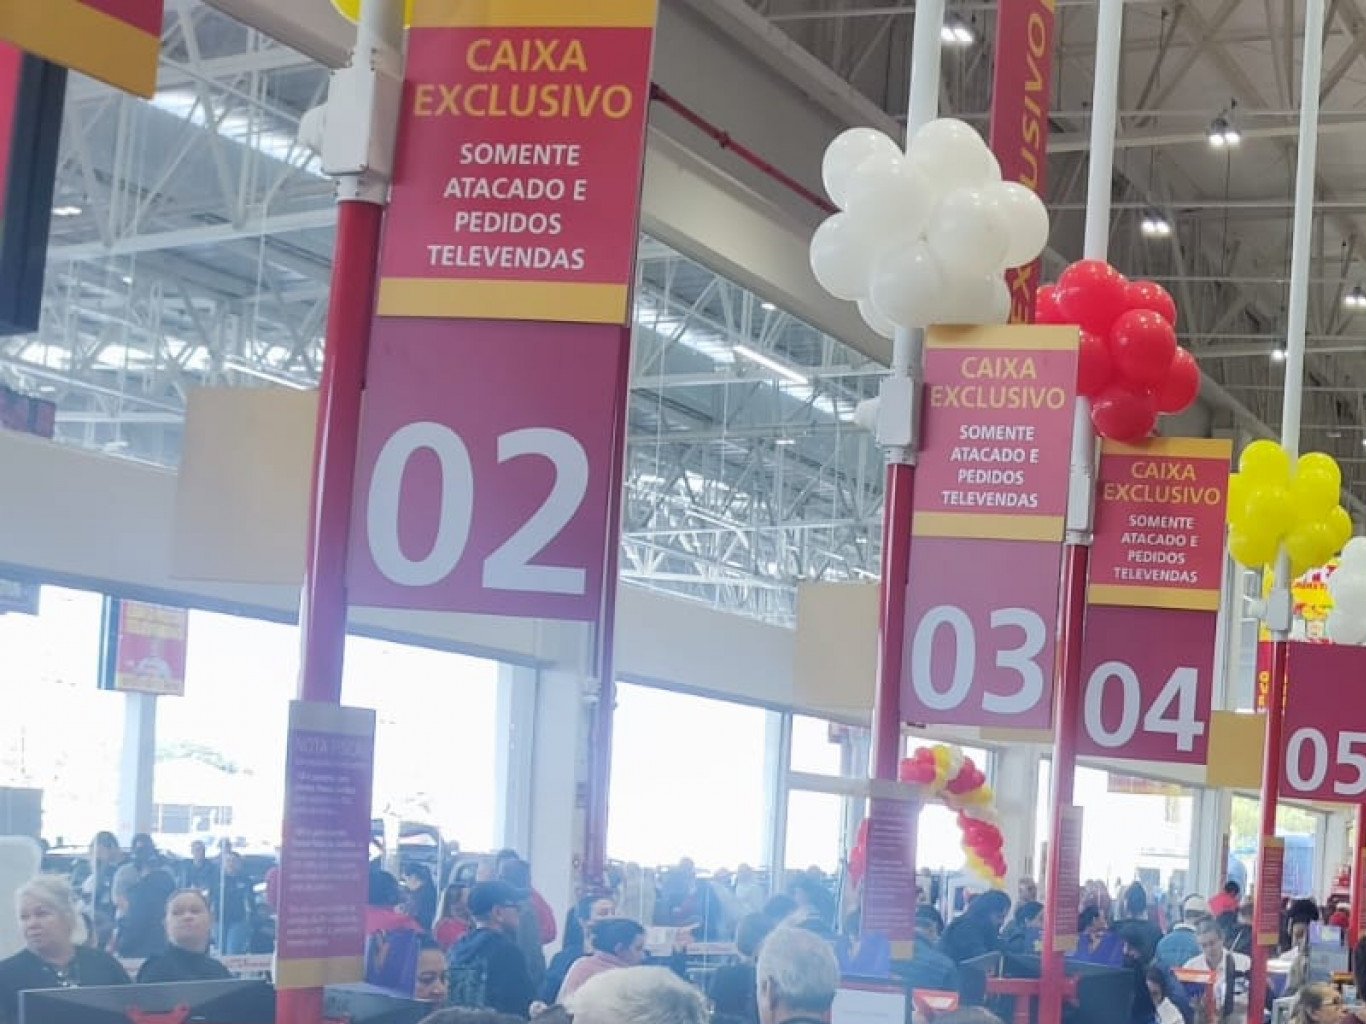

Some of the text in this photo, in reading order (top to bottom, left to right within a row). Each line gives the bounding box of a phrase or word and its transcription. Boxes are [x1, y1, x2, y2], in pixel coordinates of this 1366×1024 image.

[466, 39, 588, 73] CAIXA
[413, 83, 633, 119] EXCLUSIVO
[460, 142, 581, 167] SOMENTE
[1009, 12, 1047, 324] EXUSIVO
[443, 177, 587, 201] ATACADO E
[455, 211, 562, 235] PEDIDOS
[427, 245, 585, 270] TELEVENDAS
[961, 356, 1038, 380] CAIXA
[930, 386, 1067, 411] EXCLUSIVO
[959, 424, 1035, 442] SOMENTE
[950, 447, 1040, 464] ATACADO E
[957, 468, 1024, 486] PEDIDOS
[1130, 461, 1197, 481] CAIXA
[941, 490, 1039, 508] TELEVENDAS
[1103, 483, 1221, 506] EXCLUSIVO
[367, 421, 589, 595] 02
[1128, 514, 1195, 530] SOMENTE
[1121, 532, 1199, 548] ATACADO E
[1127, 549, 1186, 565] PEDIDOS
[1113, 566, 1199, 583] TELEVENDAS
[911, 604, 1047, 714] 03
[1083, 660, 1206, 752] 04
